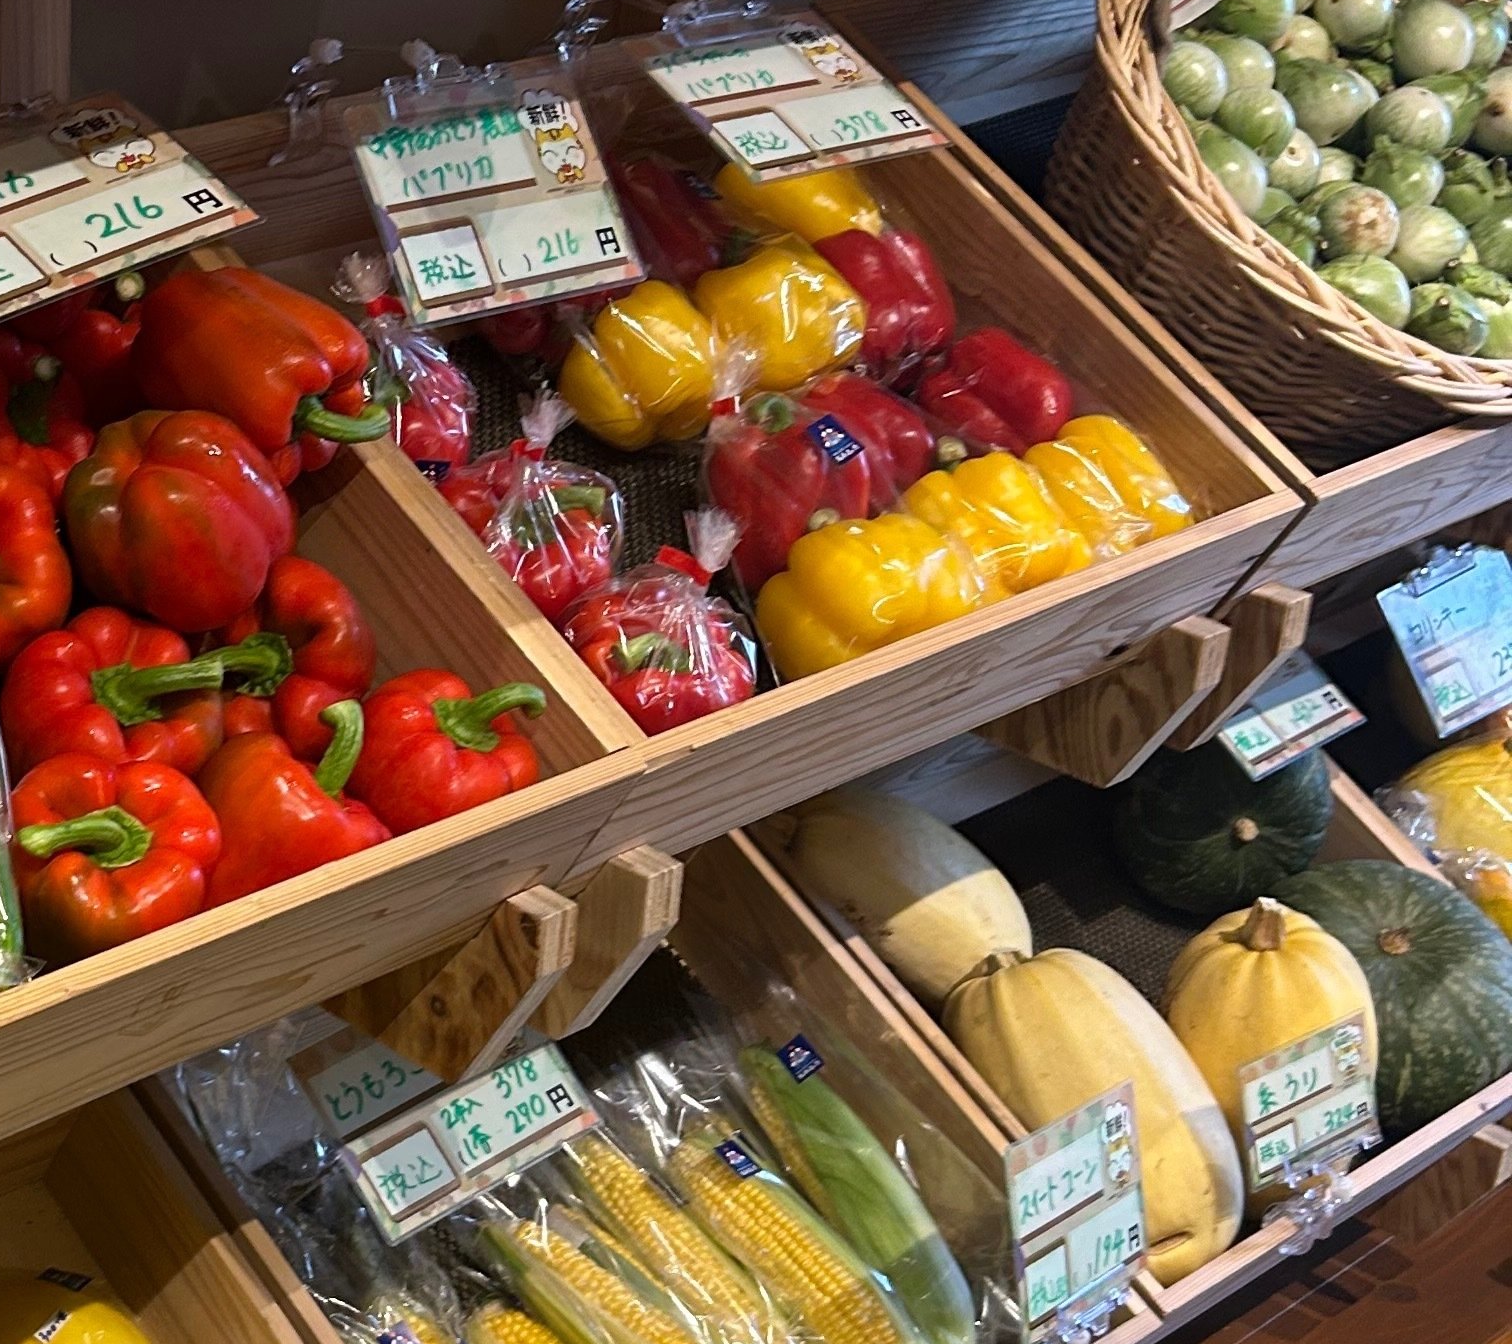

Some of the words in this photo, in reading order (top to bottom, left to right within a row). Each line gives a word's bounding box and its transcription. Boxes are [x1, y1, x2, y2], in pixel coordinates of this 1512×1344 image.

[734, 129, 789, 158] 税込
[834, 109, 889, 141] 378
[889, 109, 922, 130] 円
[402, 154, 495, 198] パプリカ
[84, 194, 164, 240] 216
[180, 187, 224, 215] 円
[418, 254, 477, 288] 税込
[537, 227, 585, 264] 216
[594, 226, 622, 257] 円
[324, 1060, 426, 1122] とうもろ
[491, 1056, 539, 1100] 378
[545, 1082, 575, 1114] 円
[377, 1155, 443, 1206] 税込
